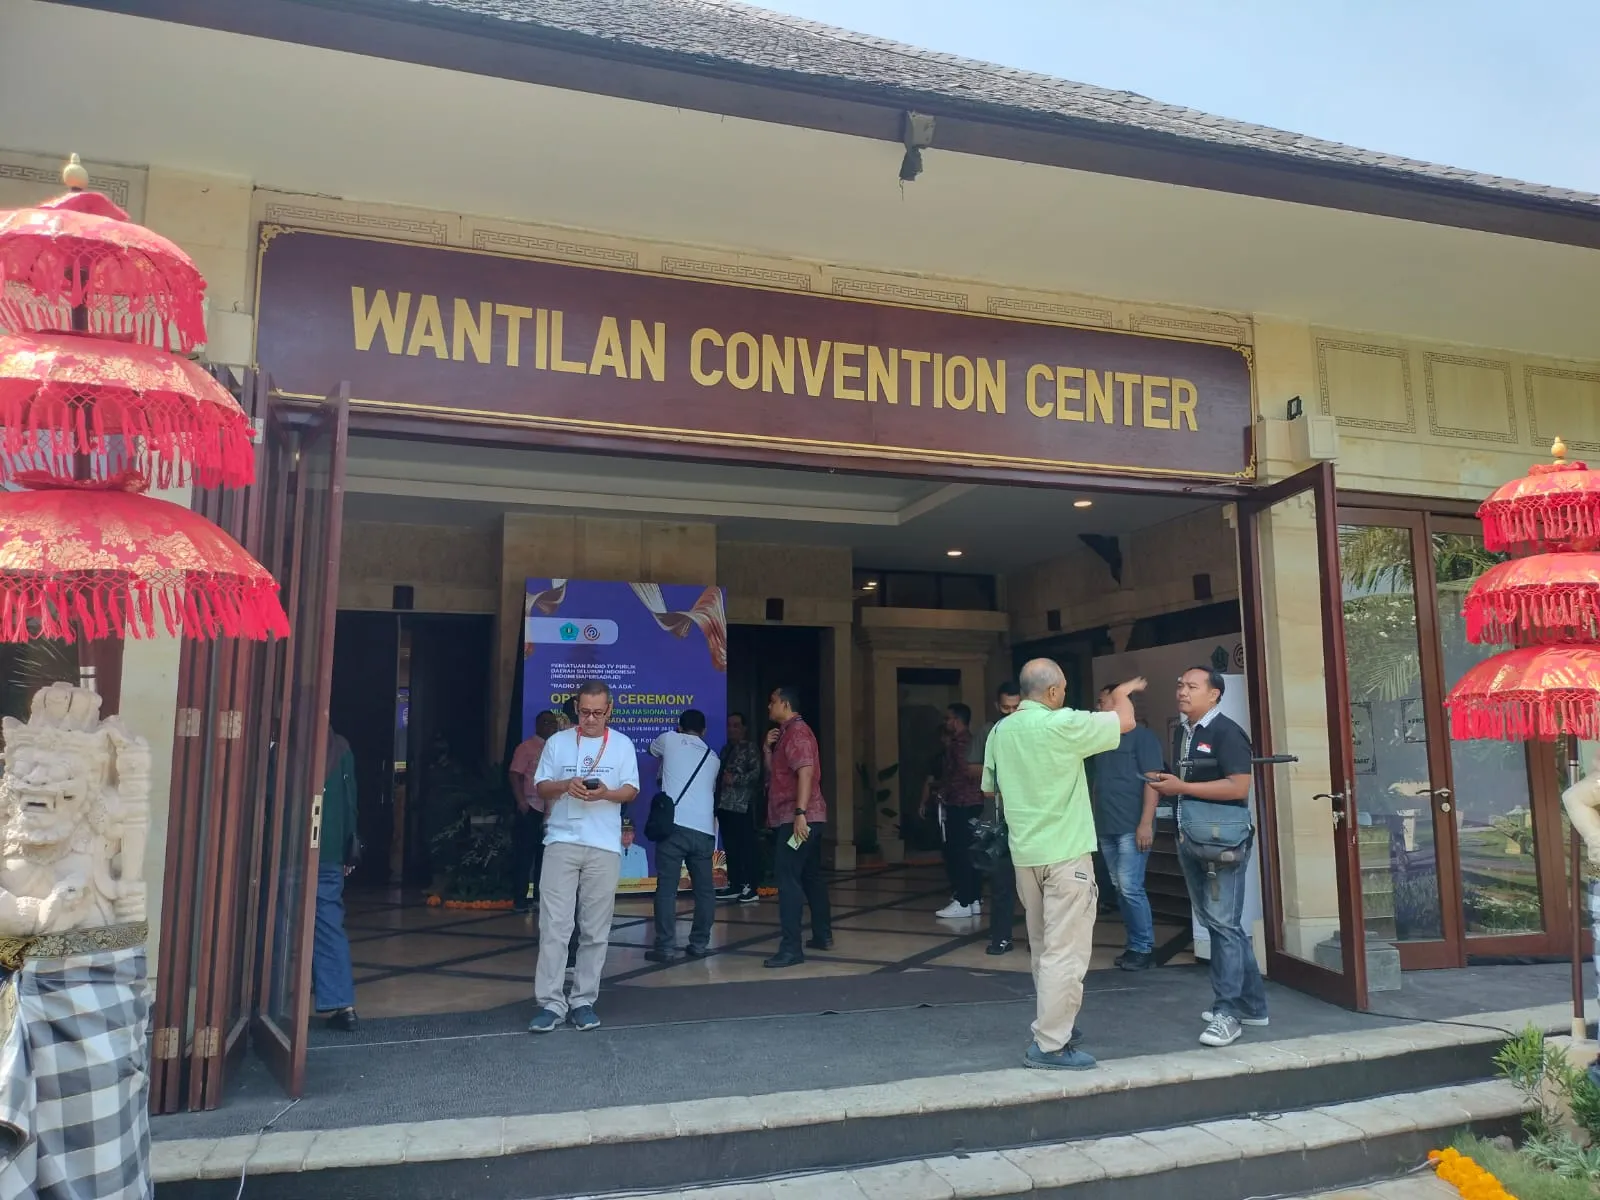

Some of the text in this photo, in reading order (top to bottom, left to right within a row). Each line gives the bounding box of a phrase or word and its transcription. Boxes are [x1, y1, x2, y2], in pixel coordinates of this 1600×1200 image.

[351, 286, 1198, 432] WANTILAN CONVENTION CENTER
[618, 693, 695, 706] CEREMONY
